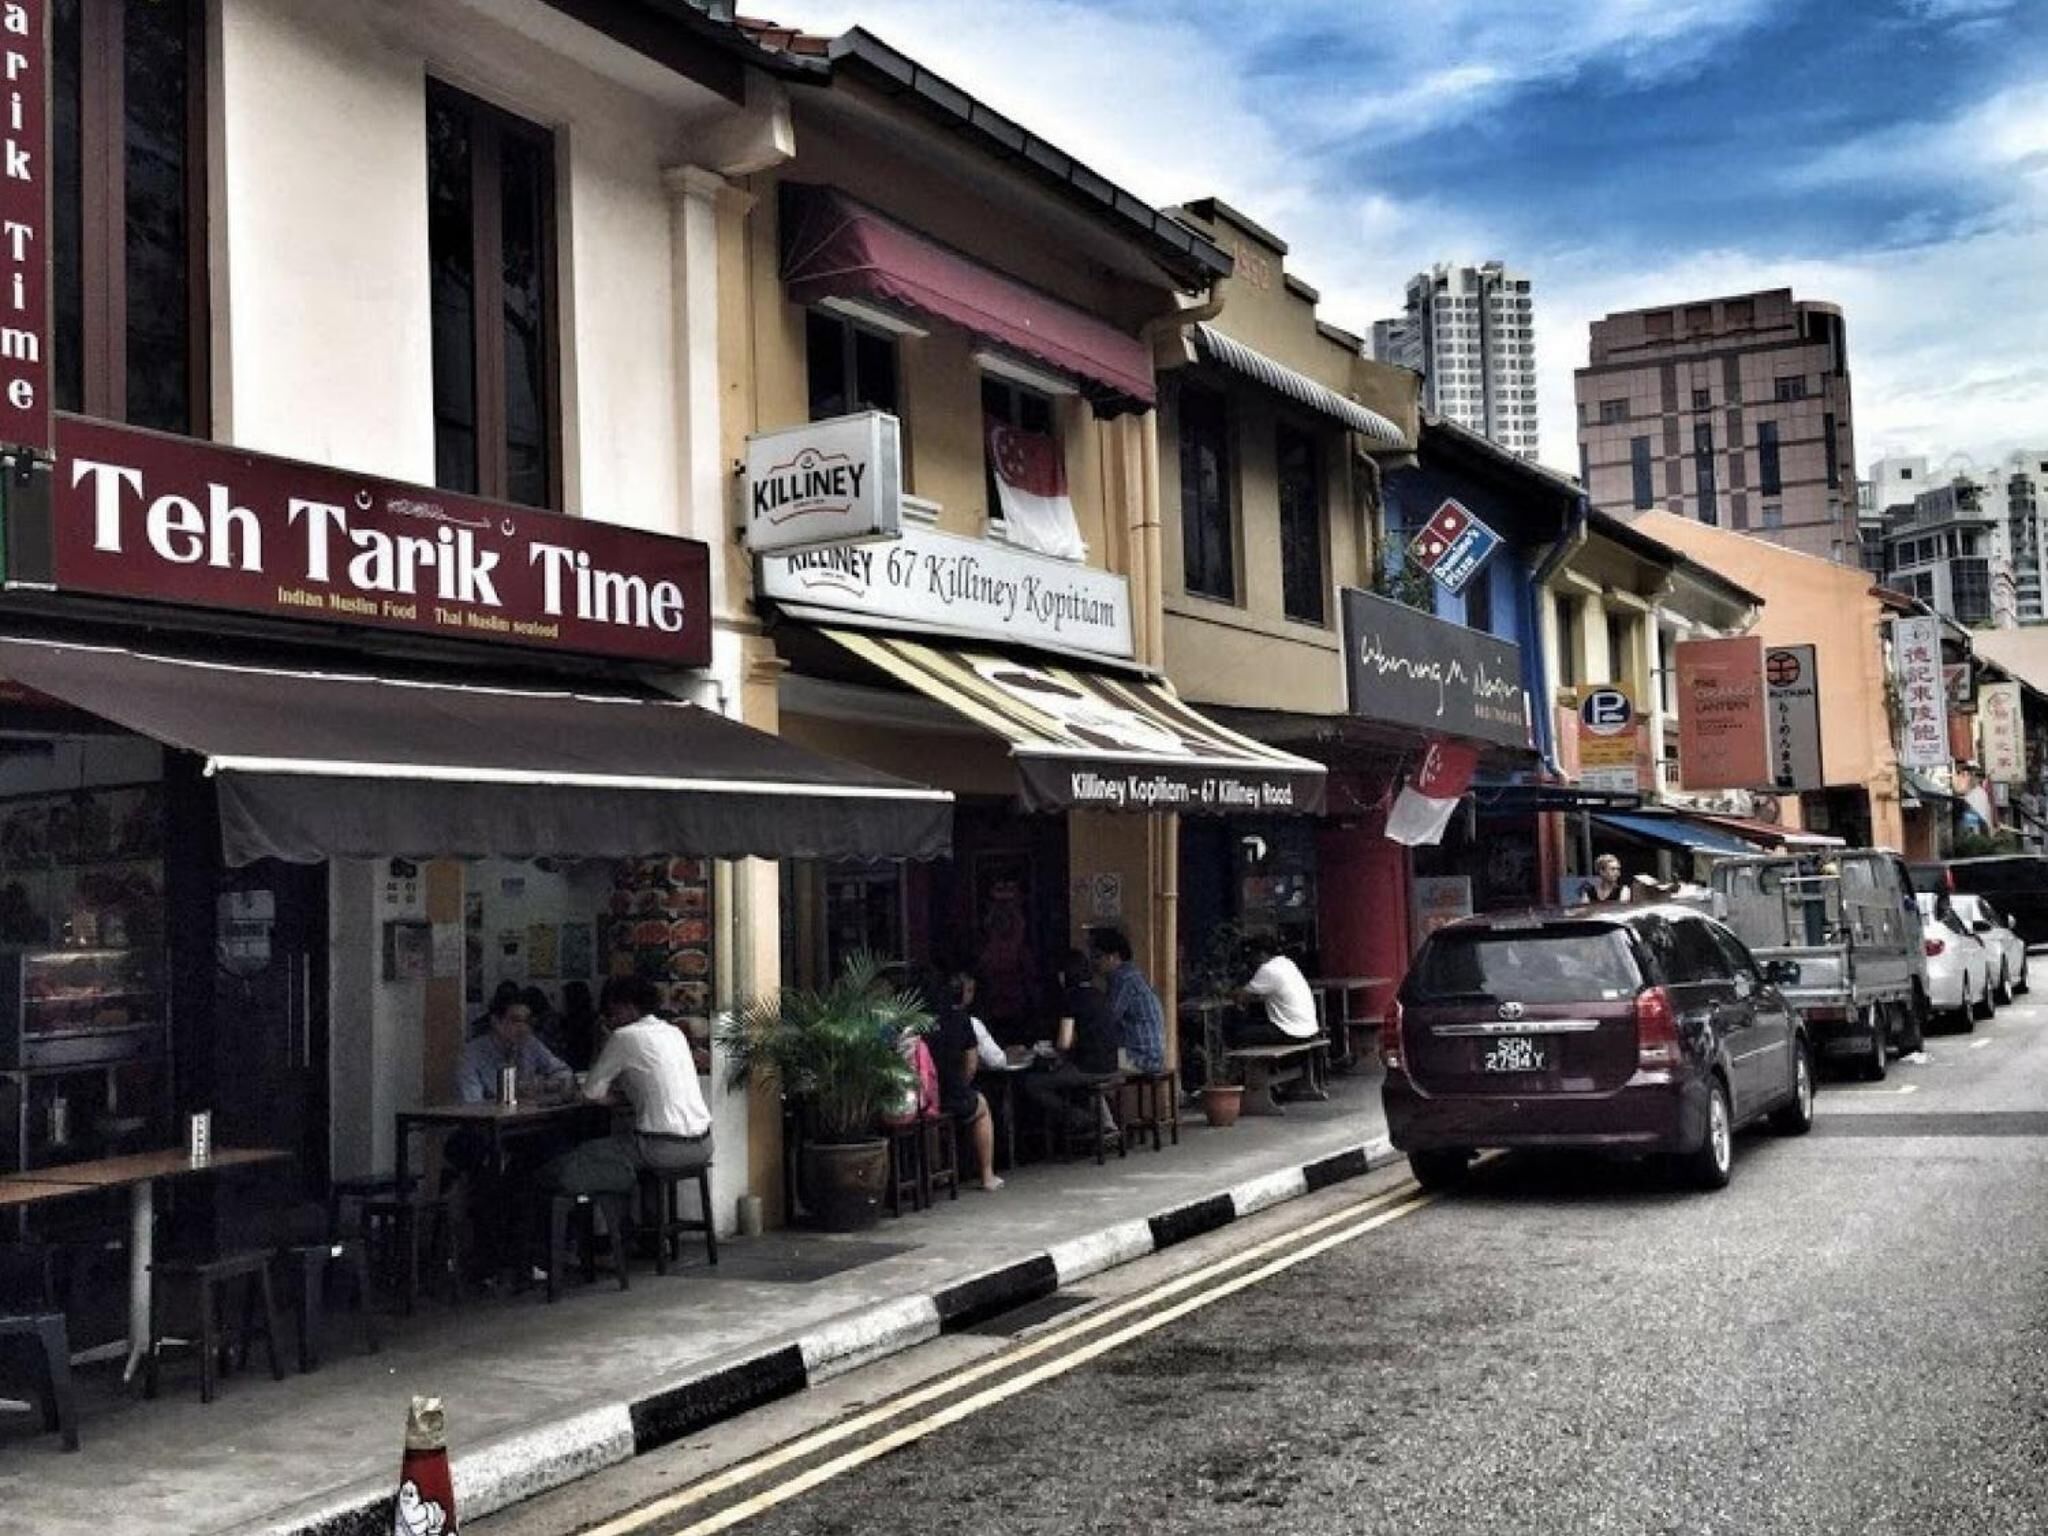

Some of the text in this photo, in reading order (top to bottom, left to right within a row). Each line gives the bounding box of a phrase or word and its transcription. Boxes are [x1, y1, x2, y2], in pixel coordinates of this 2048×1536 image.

[1, 220, 39, 409] Time
[752, 462, 865, 519] KILLINEY
[72, 458, 685, 632] Teh Tarik Time
[277, 585, 417, 619] Indian Muslim Food
[787, 547, 1116, 631] KILLINEY 67 Killiney Kopitiam
[434, 607, 463, 627] Thai
[468, 610, 511, 632] Muslim
[1071, 773, 1126, 807] Killiney
[1128, 775, 1189, 807] Kopitiam
[1201, 779, 1215, 802] 67
[1219, 780, 1260, 809] Killiney
[1262, 781, 1293, 804] Road
